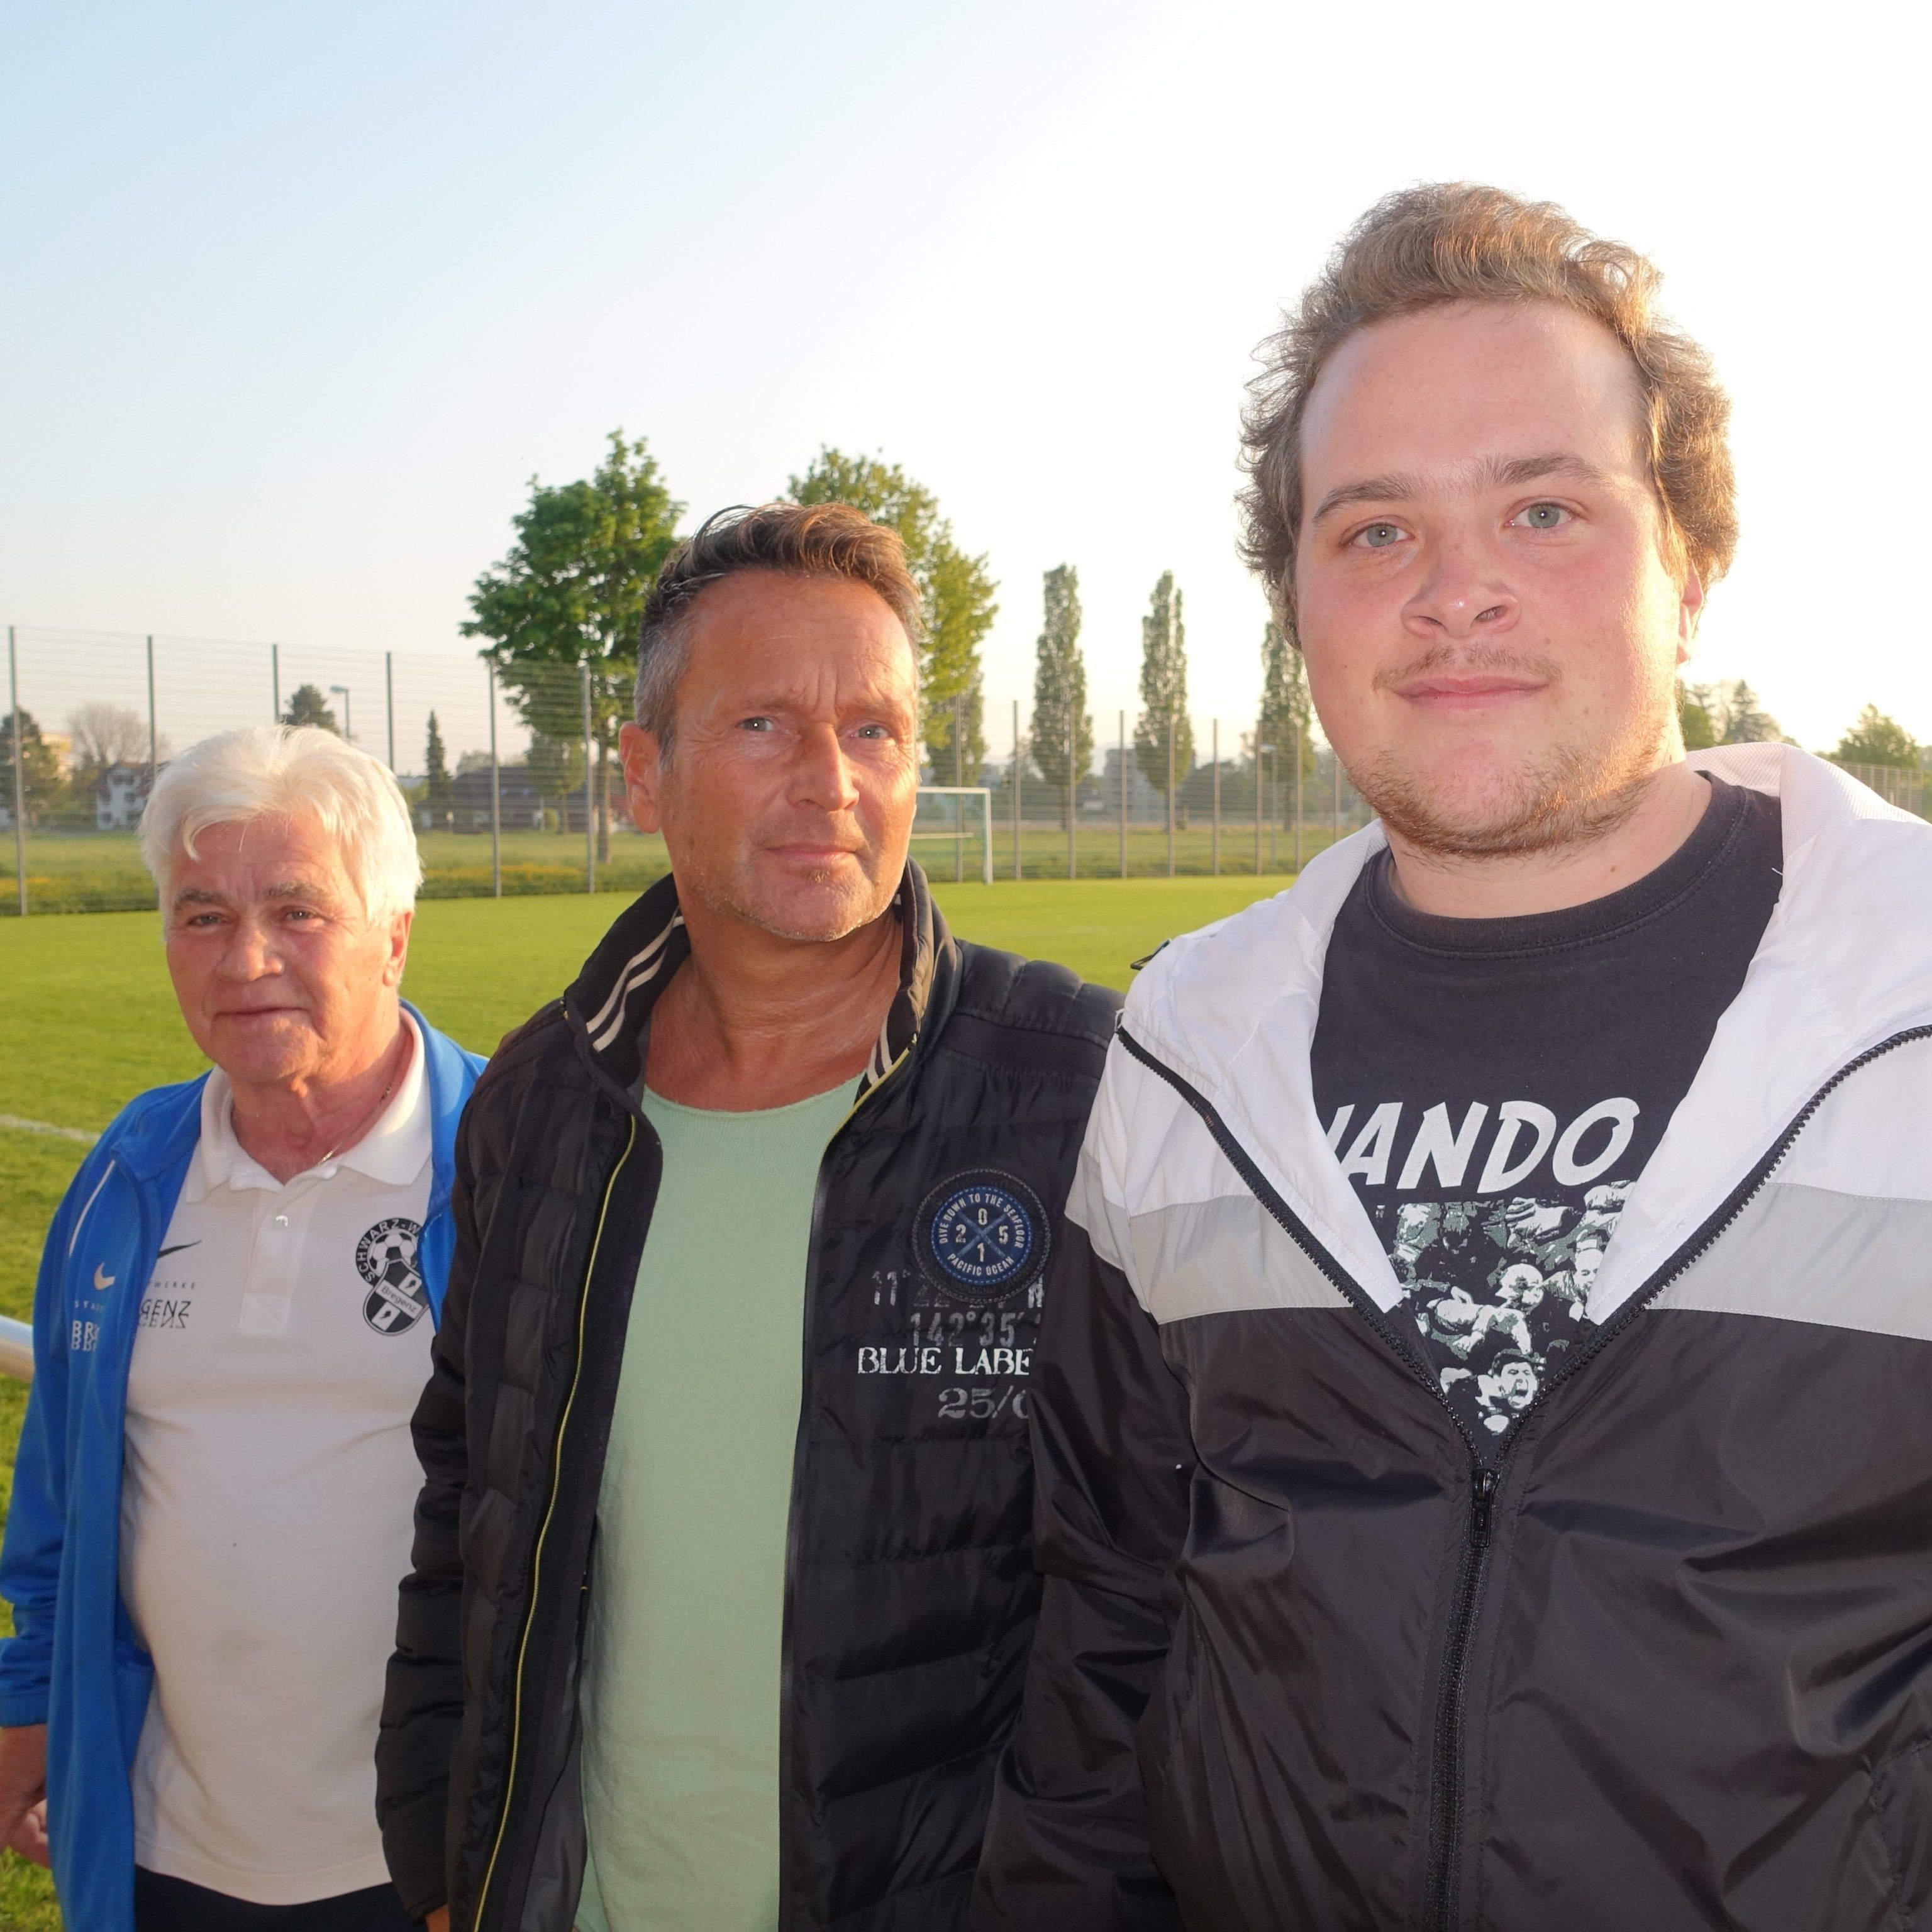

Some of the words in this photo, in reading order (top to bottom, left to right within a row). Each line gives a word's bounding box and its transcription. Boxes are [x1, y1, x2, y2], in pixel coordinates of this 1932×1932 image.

[943, 1197, 967, 1222] DOWN
[969, 1193, 980, 1203] TO
[985, 1193, 1003, 1208] THE
[978, 1208, 987, 1225] 0
[1004, 1204, 1025, 1248] SEAFLOOR
[939, 1222, 949, 1245] DIVE
[955, 1224, 966, 1243] 2
[999, 1225, 1009, 1245] 5
[977, 1243, 985, 1262] 1
[947, 1253, 982, 1276] PACIFIC
[985, 1256, 1014, 1275] OCEAN
[381, 1285, 418, 1313] Bregenz
[858, 1346, 942, 1374] BLUE
